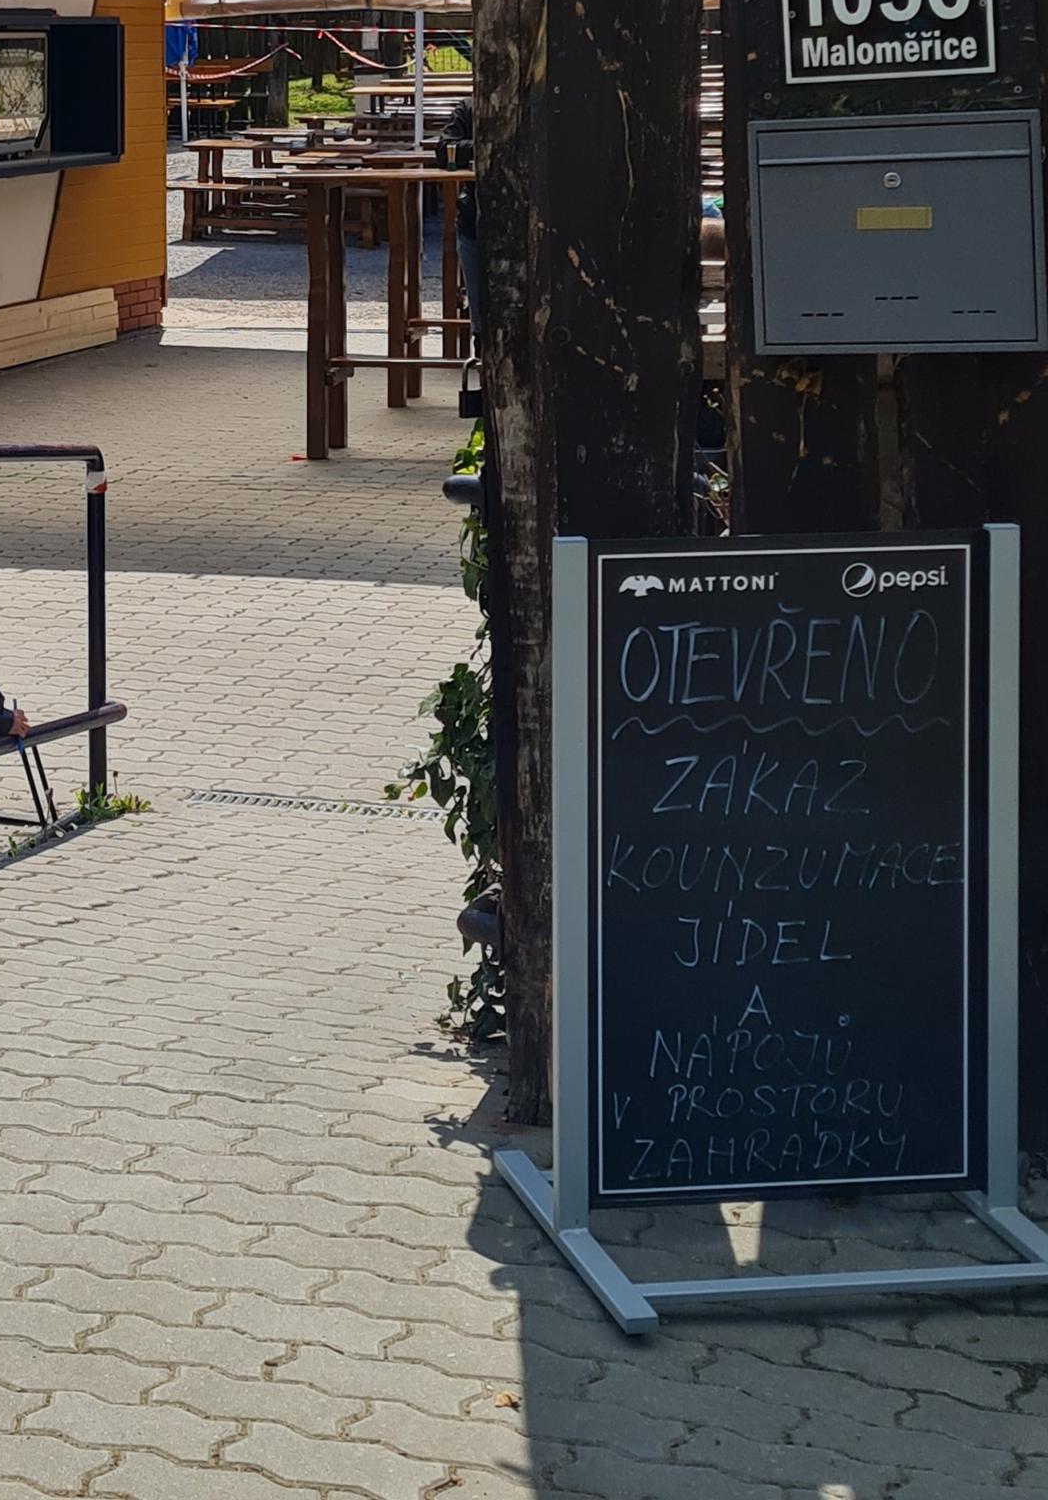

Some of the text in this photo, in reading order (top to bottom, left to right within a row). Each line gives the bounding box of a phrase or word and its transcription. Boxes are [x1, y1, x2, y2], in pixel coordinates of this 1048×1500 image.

[801, 30, 978, 69] Maloměřice
[668, 565, 947, 594] MATTONI pepsi
[619, 602, 940, 705] OTEVŘENO
[651, 740, 871, 815] ZÁKAZ
[674, 900, 852, 967] JÍDEL
[737, 984, 773, 1027] A
[649, 1014, 853, 1079] NÁPOJŮ
[667, 1078, 904, 1123] PROSTORU
[627, 1120, 907, 1181] ZAHRÁDKY
